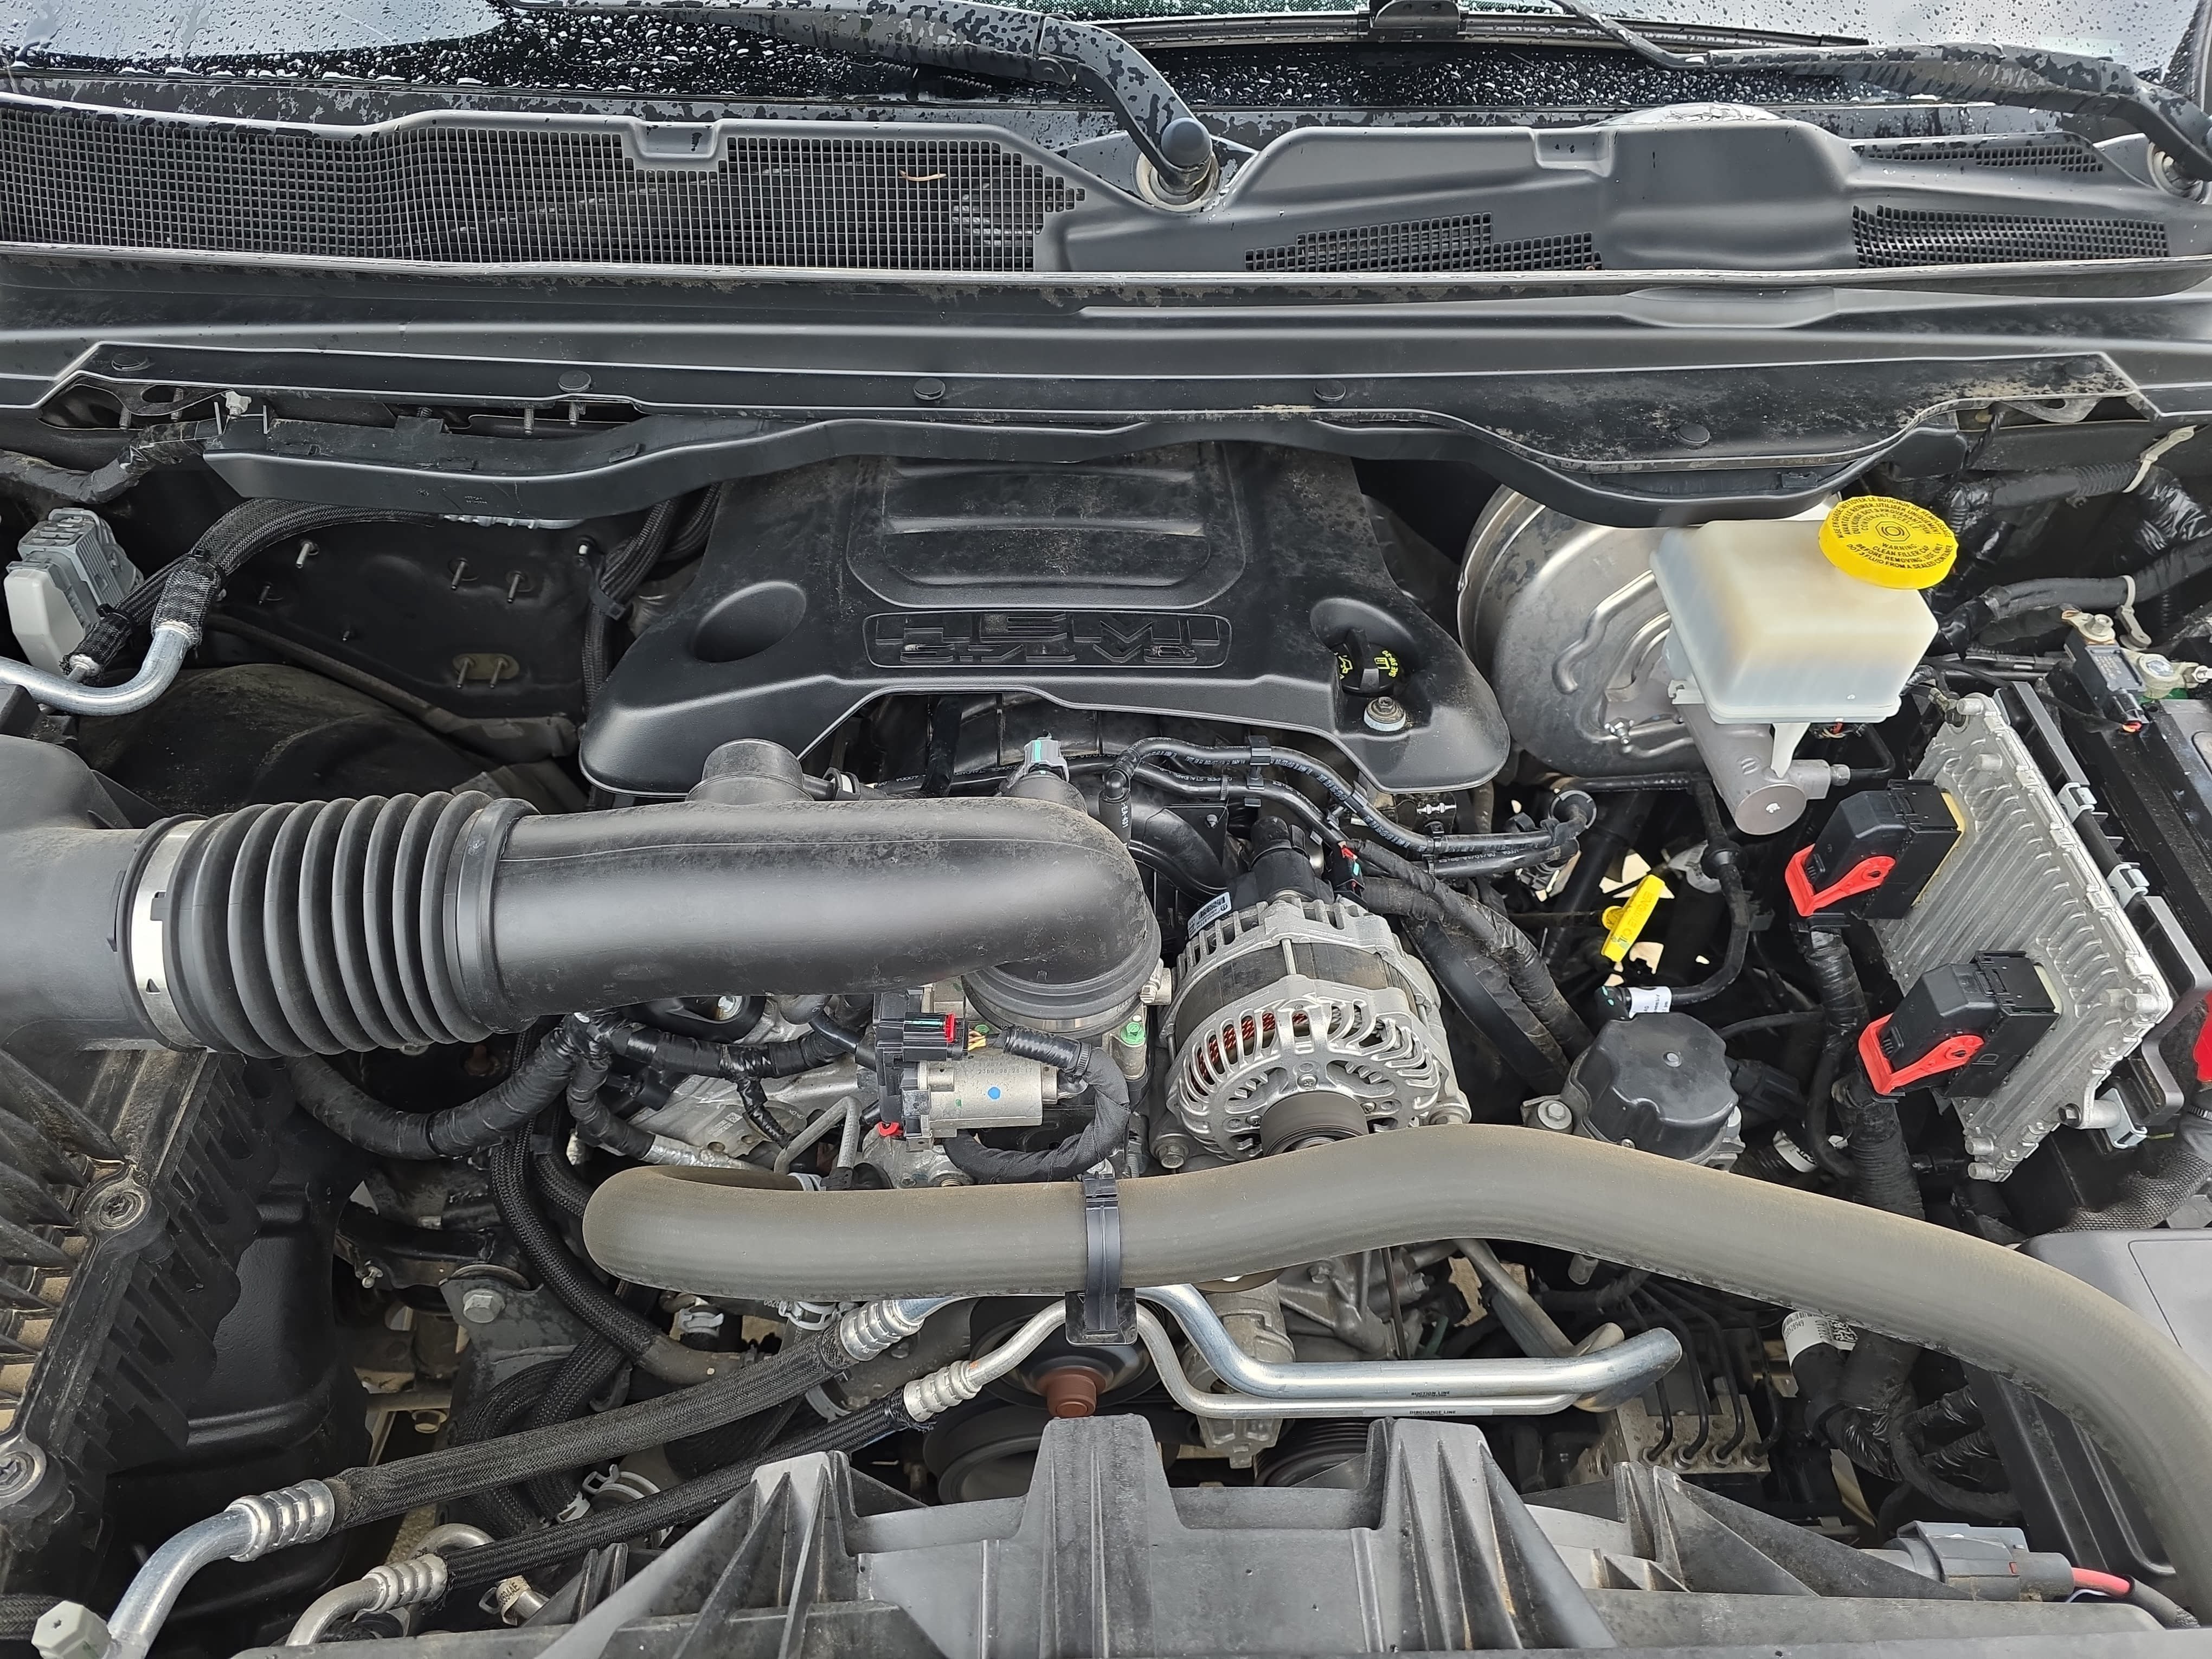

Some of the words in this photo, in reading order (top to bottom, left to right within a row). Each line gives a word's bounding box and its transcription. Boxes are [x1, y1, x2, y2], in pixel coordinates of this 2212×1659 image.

[1841, 497, 1866, 509] NETTOYER
[1877, 497, 1910, 508] BOUCHON
[1920, 511, 1952, 538] REMPLISSAGE
[1841, 521, 1853, 535] AVANT
[1875, 503, 1906, 512] UTILISER
[1907, 510, 1941, 535] UNIQUEMENT
[1861, 513, 1889, 531] CONTENANT
[1879, 508, 1922, 524] PROVENANT
[1855, 543, 1883, 558] BEFORE
[1932, 543, 1944, 554] ONLY
[1873, 546, 1896, 556] CLEAN
[1919, 545, 1930, 553] CAP
[1882, 542, 1919, 550] WARNING:
[1846, 544, 1861, 552] DOT
[1864, 554, 1884, 564] FLUID
[1912, 561, 1937, 569] SEALED
[1934, 544, 1953, 564] CONTAINER
[1387, 666, 1399, 678] SAE
[1627, 891, 1654, 929] ENGINE
[1617, 928, 1632, 943] OIL
